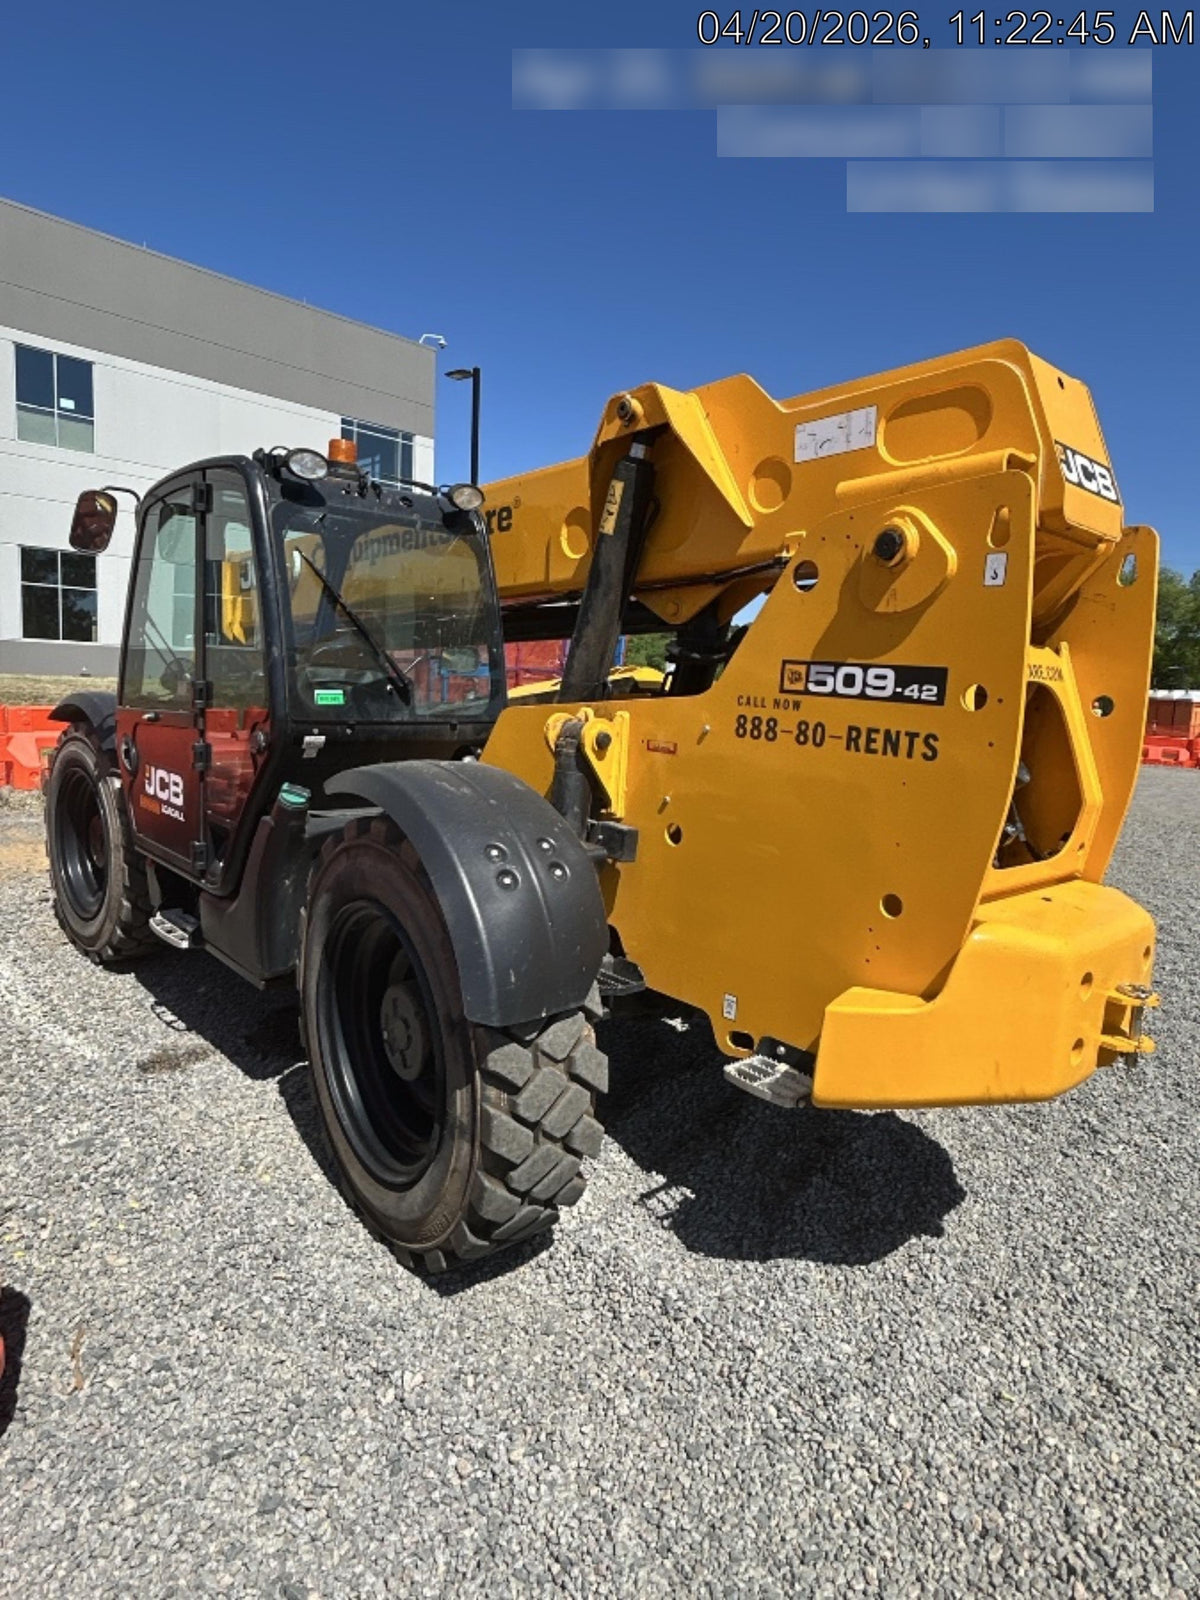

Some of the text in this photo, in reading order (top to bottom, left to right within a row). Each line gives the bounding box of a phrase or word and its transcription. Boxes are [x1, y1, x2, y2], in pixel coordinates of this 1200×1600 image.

[1061, 449, 1118, 501] JCB
[737, 694, 802, 712] CALL NOW
[735, 714, 940, 762] 888-80-RENTS
[145, 766, 184, 806] JCB
